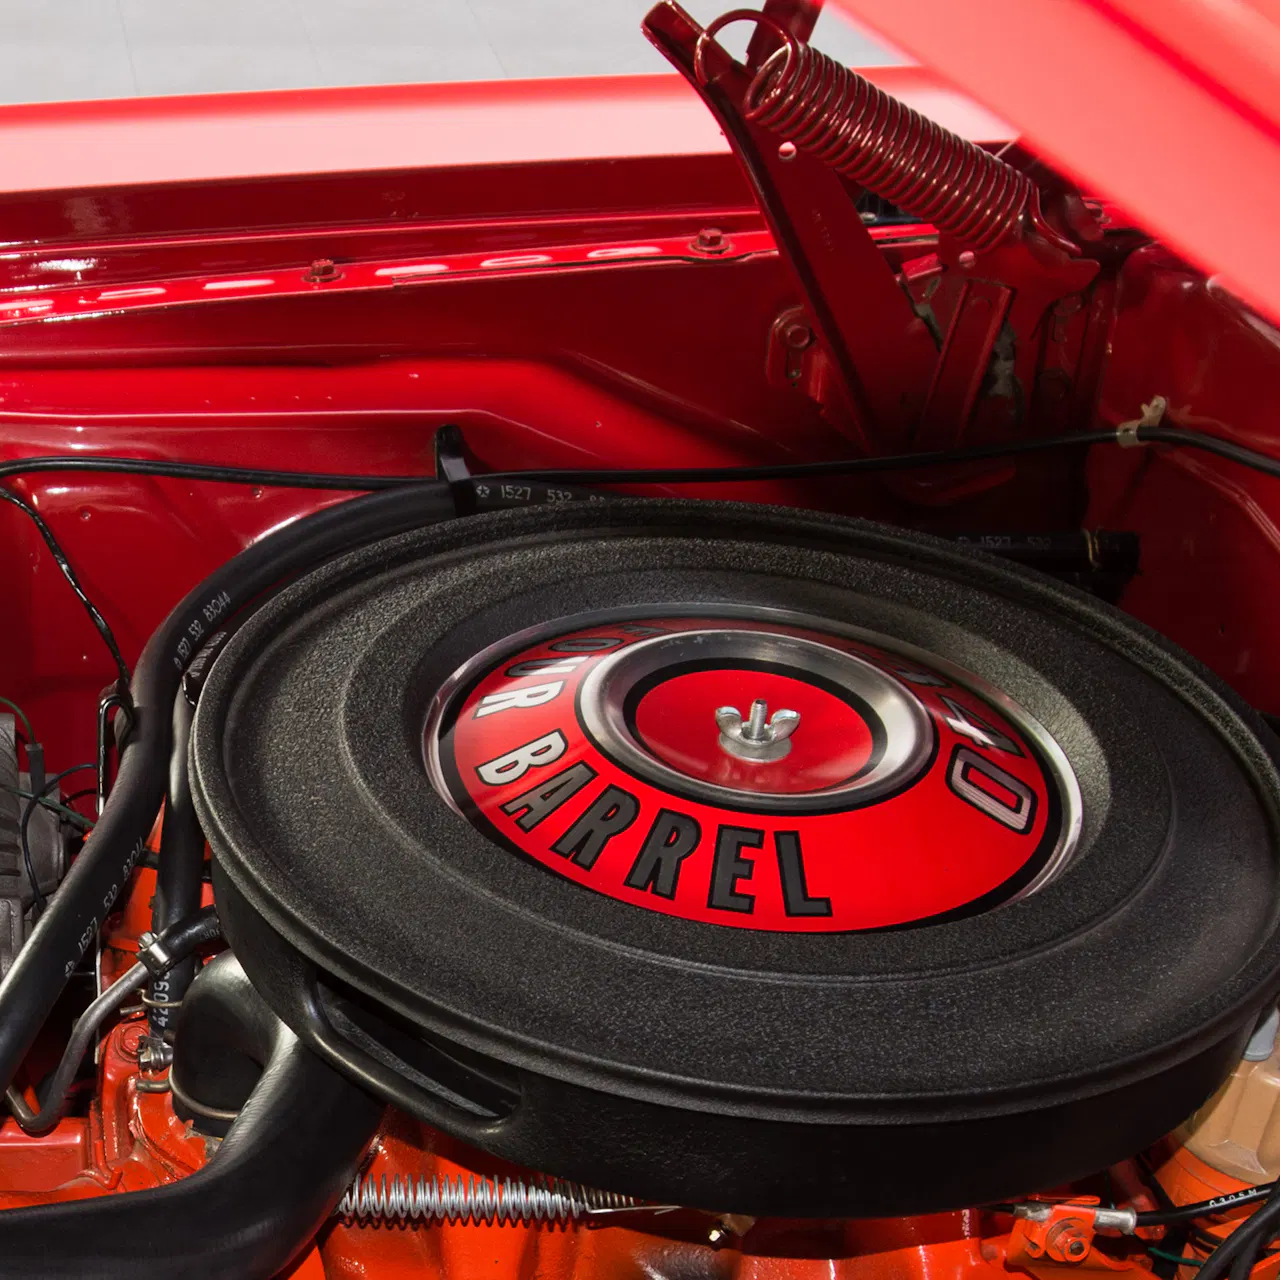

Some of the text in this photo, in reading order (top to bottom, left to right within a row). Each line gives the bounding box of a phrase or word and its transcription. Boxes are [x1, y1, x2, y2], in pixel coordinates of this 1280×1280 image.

[500, 485, 532, 501] 1527
[546, 488, 573, 503] 532
[475, 731, 834, 919] BARREL
